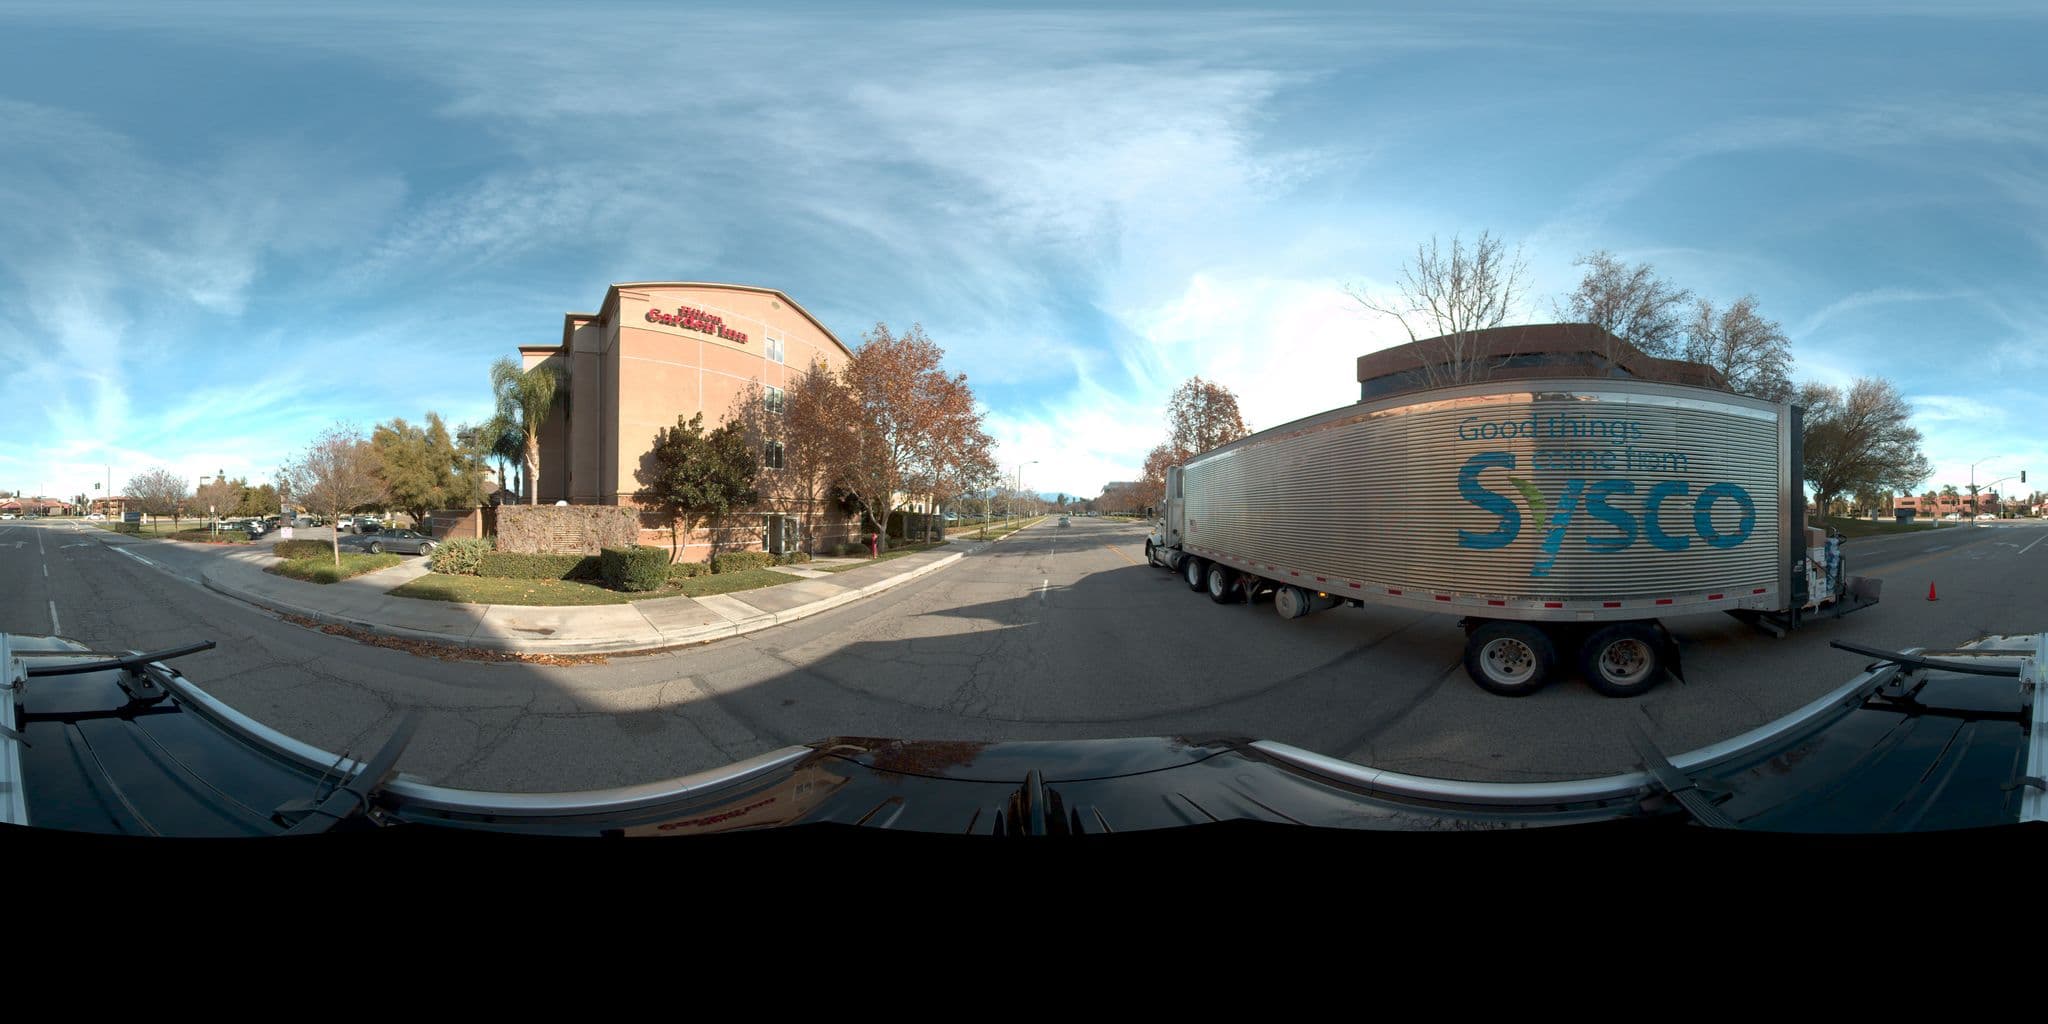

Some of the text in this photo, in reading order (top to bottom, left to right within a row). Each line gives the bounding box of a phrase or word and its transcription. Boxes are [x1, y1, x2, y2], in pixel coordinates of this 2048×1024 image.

[646, 308, 749, 344] Garden Inn
[679, 305, 723, 325] Hilton
[1458, 412, 1642, 444] Good things
[1532, 446, 1688, 471] come from
